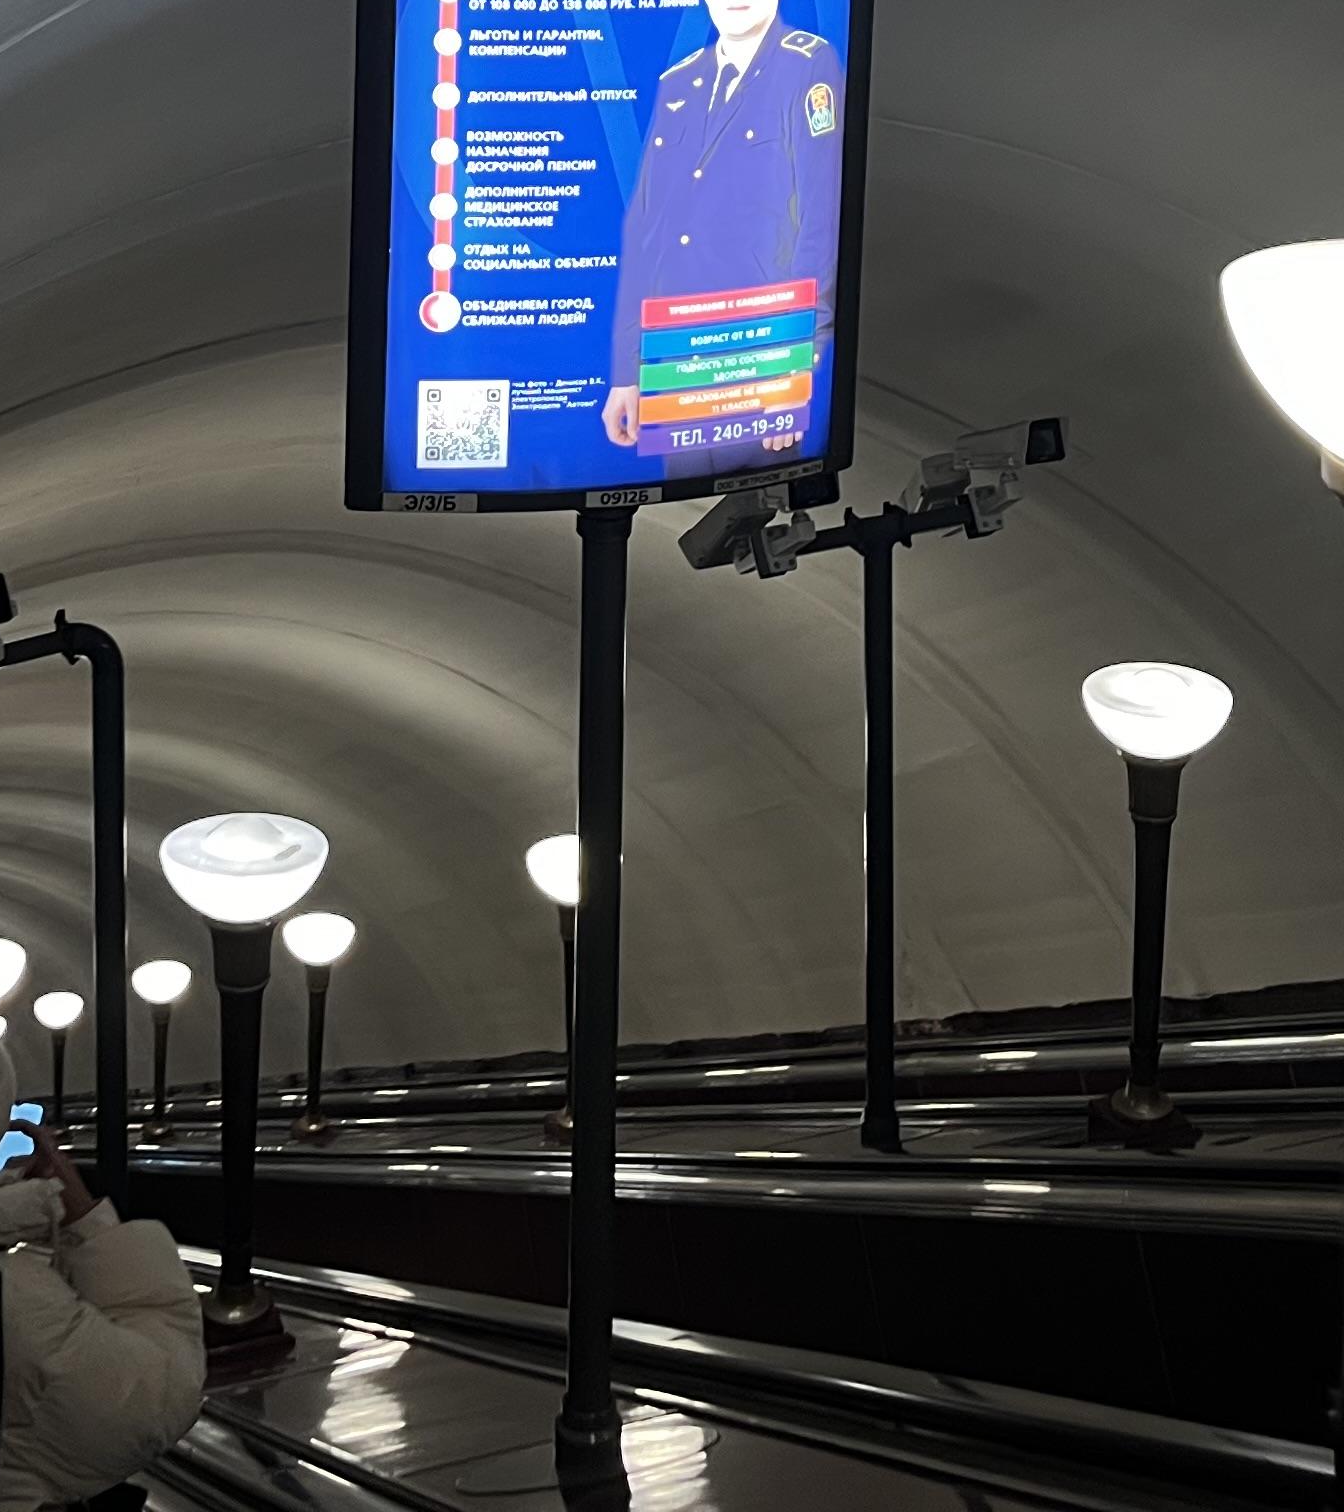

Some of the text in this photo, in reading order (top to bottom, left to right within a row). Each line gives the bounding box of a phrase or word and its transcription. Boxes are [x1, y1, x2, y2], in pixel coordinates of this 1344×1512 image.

[469, 0, 486, 10] ОТ
[539, 0, 558, 12] ДО
[469, 29, 604, 41] ЛЬГОТЫ И ГАРАНТИИ,
[469, 45, 566, 57] КОМПЕНСАЦИИ
[467, 88, 637, 103] ДОПОЛНИТЕЛЬНЫЙ ОТПУСК
[466, 131, 565, 142] ВОЗМОЖНОСТЬ
[466, 146, 549, 157] НАЗНАЧЕНИЯ
[465, 159, 596, 174] ДОСРОЧНОЙ ПЕНСИИ
[465, 185, 581, 199] ДОПОЛНИТЕЛЬНОЕ
[465, 201, 559, 213] МЕДИЦИНСКОЕ
[464, 216, 553, 227] СТРАХОВАНИЕ
[464, 244, 531, 256] ОТДЫХ НА
[463, 256, 617, 271] СОЦИАЛЬНЫХ ОБЪЕКТАХ
[462, 299, 548, 312] ОБЪЕДИНЯЕМ
[462, 311, 586, 326] СБЛИЖАЕМ ЛЮДЕЙ!
[690, 332, 730, 347] ВОЗРАСТ
[731, 330, 743, 341] ОТ
[724, 357, 737, 368] ПО
[670, 414, 794, 447] ТЕЛ. 240-19-99
[600, 489, 649, 505] 0912Б
